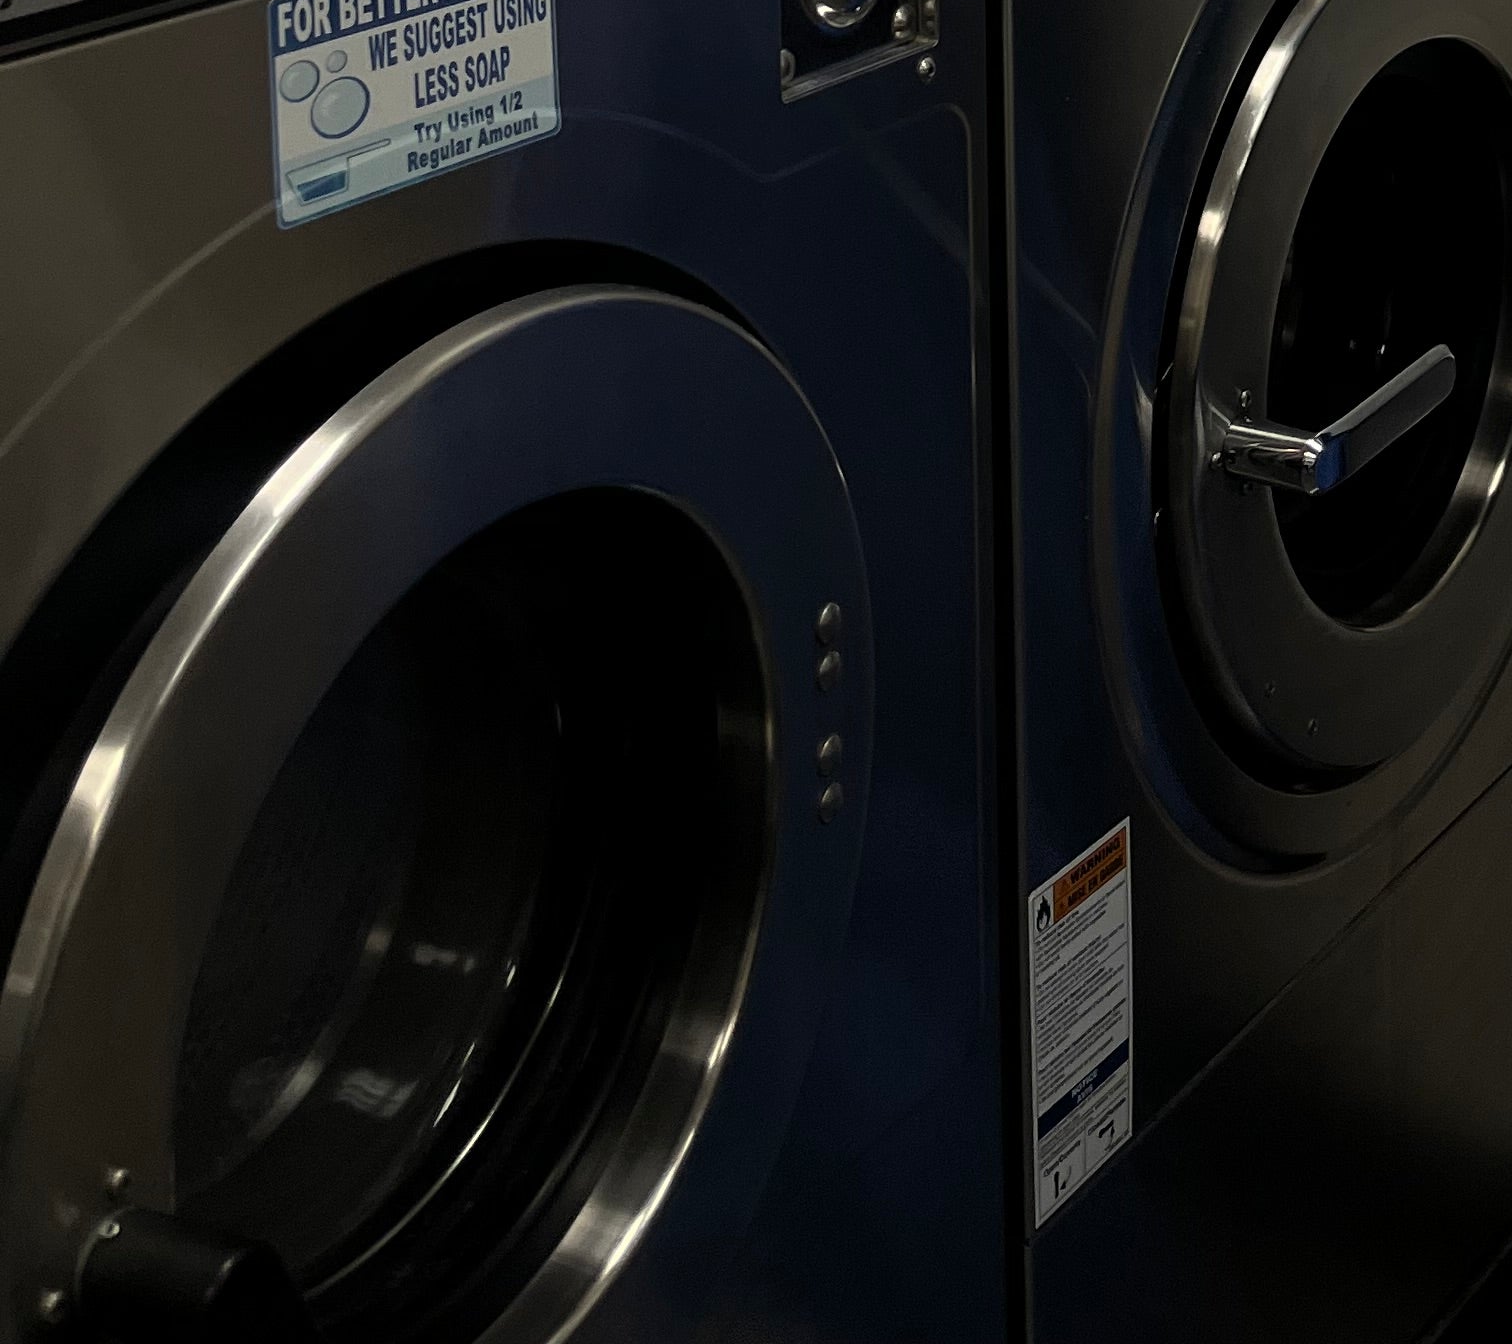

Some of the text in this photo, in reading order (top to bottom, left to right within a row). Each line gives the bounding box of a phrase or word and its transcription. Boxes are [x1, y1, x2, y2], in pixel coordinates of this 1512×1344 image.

[368, 29, 399, 71] WE
[403, 2, 488, 62] SUGGEST
[414, 45, 511, 109] LESS SOAP
[407, 111, 538, 173] Regular Amount
[414, 91, 523, 144] Try Using 1/2
[1070, 837, 1121, 884] WARNING
